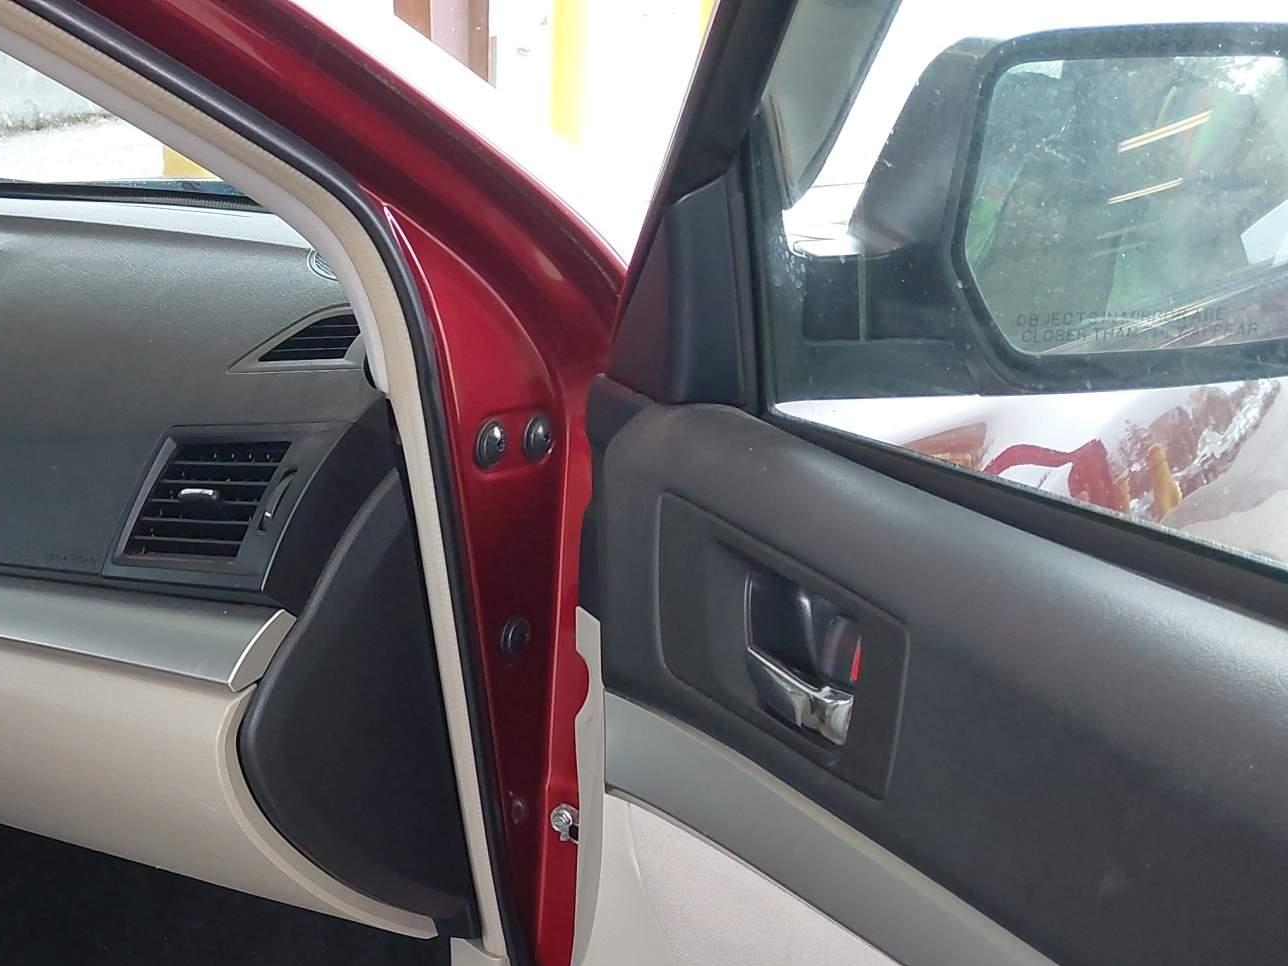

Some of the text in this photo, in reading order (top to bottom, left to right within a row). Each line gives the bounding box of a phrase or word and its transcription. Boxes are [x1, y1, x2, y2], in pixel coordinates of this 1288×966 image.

[1015, 310, 1099, 328] OBJECTS
[1118, 307, 1186, 324] MIRR
[1021, 327, 1088, 344] CLOSER
[1094, 325, 1139, 341] THAN
[1191, 321, 1259, 339] APPEAR
